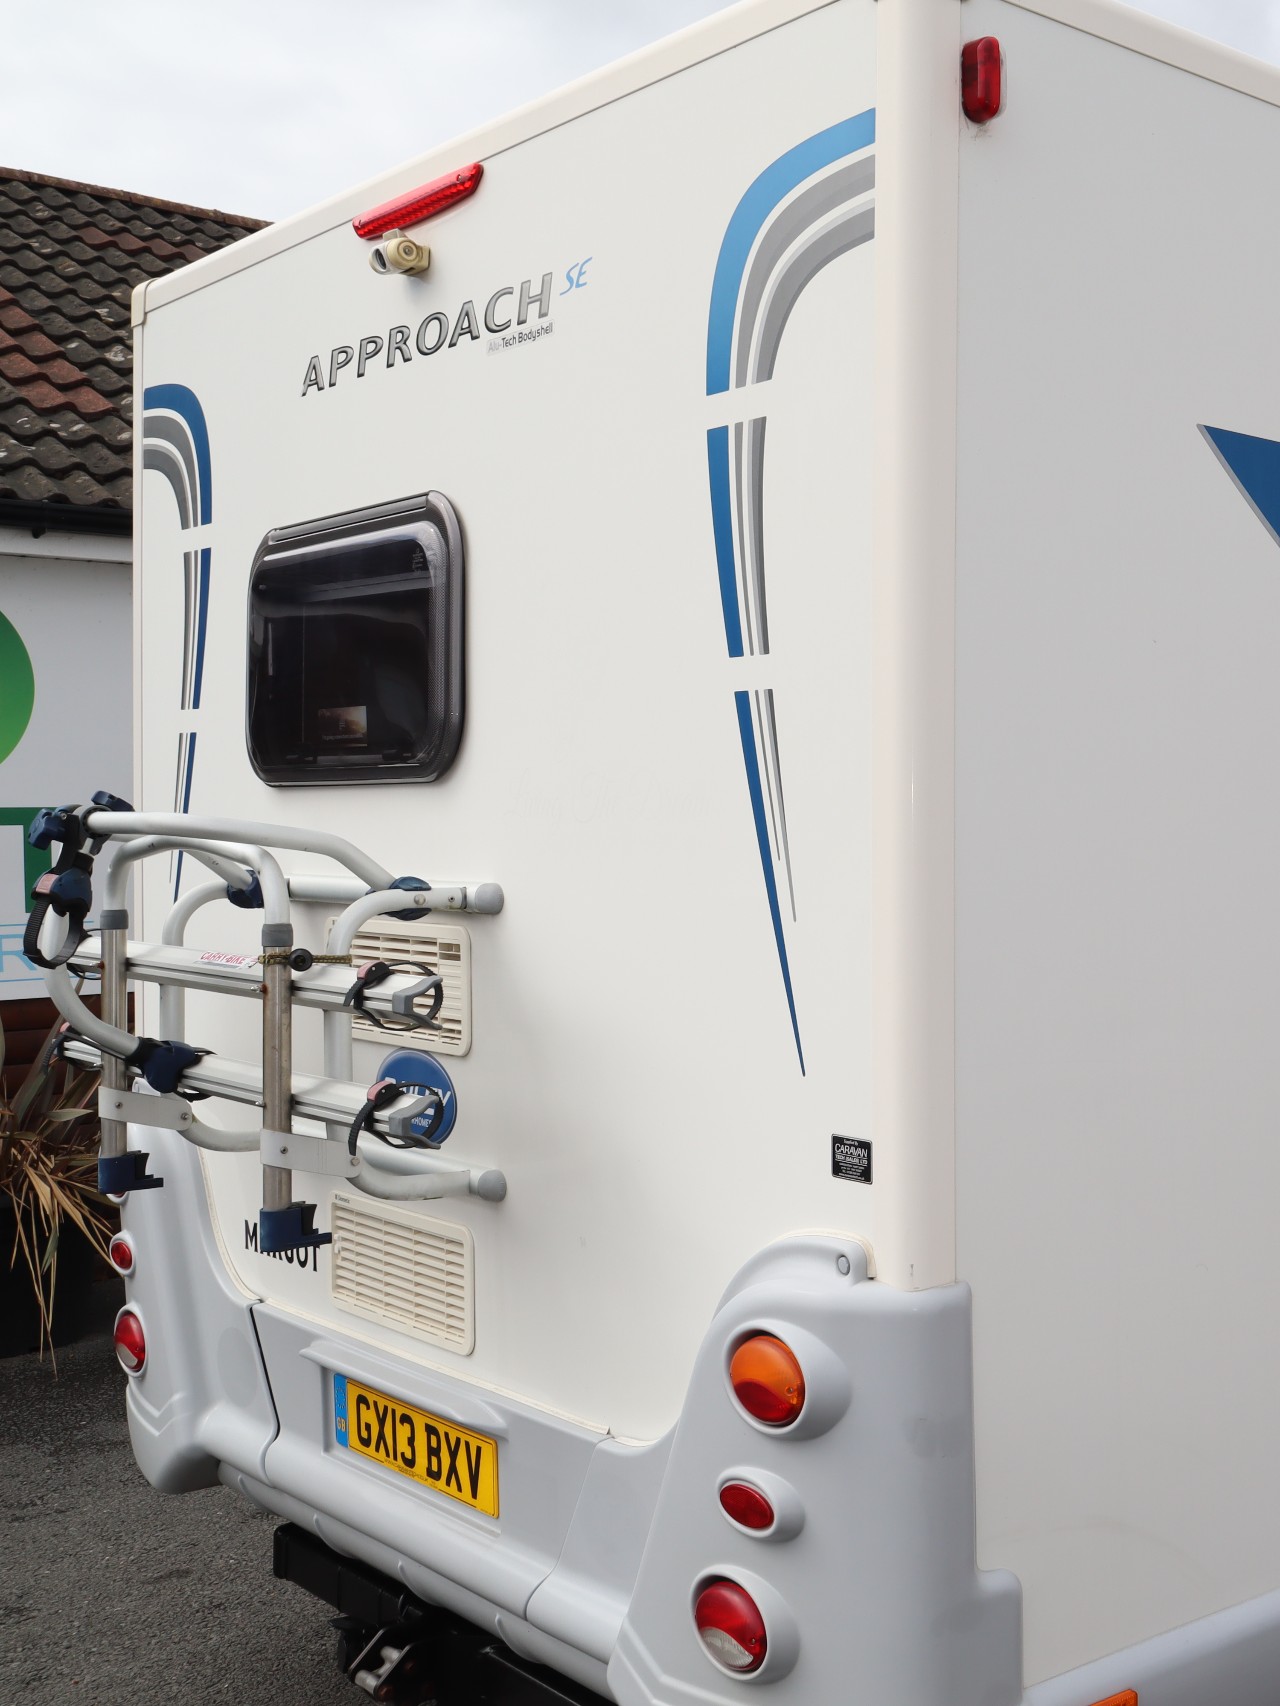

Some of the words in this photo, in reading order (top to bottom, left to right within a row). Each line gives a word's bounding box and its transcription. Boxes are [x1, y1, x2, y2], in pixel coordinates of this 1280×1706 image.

[301, 271, 554, 397] APPROACH
[559, 256, 593, 296] SE
[487, 334, 517, 354] Alu-Tech
[518, 321, 554, 343] Bodyshell
[834, 1143, 868, 1158] CARAVAN
[336, 1416, 346, 1432] GB
[355, 1393, 417, 1470] GX13
[424, 1421, 482, 1501] BXV
